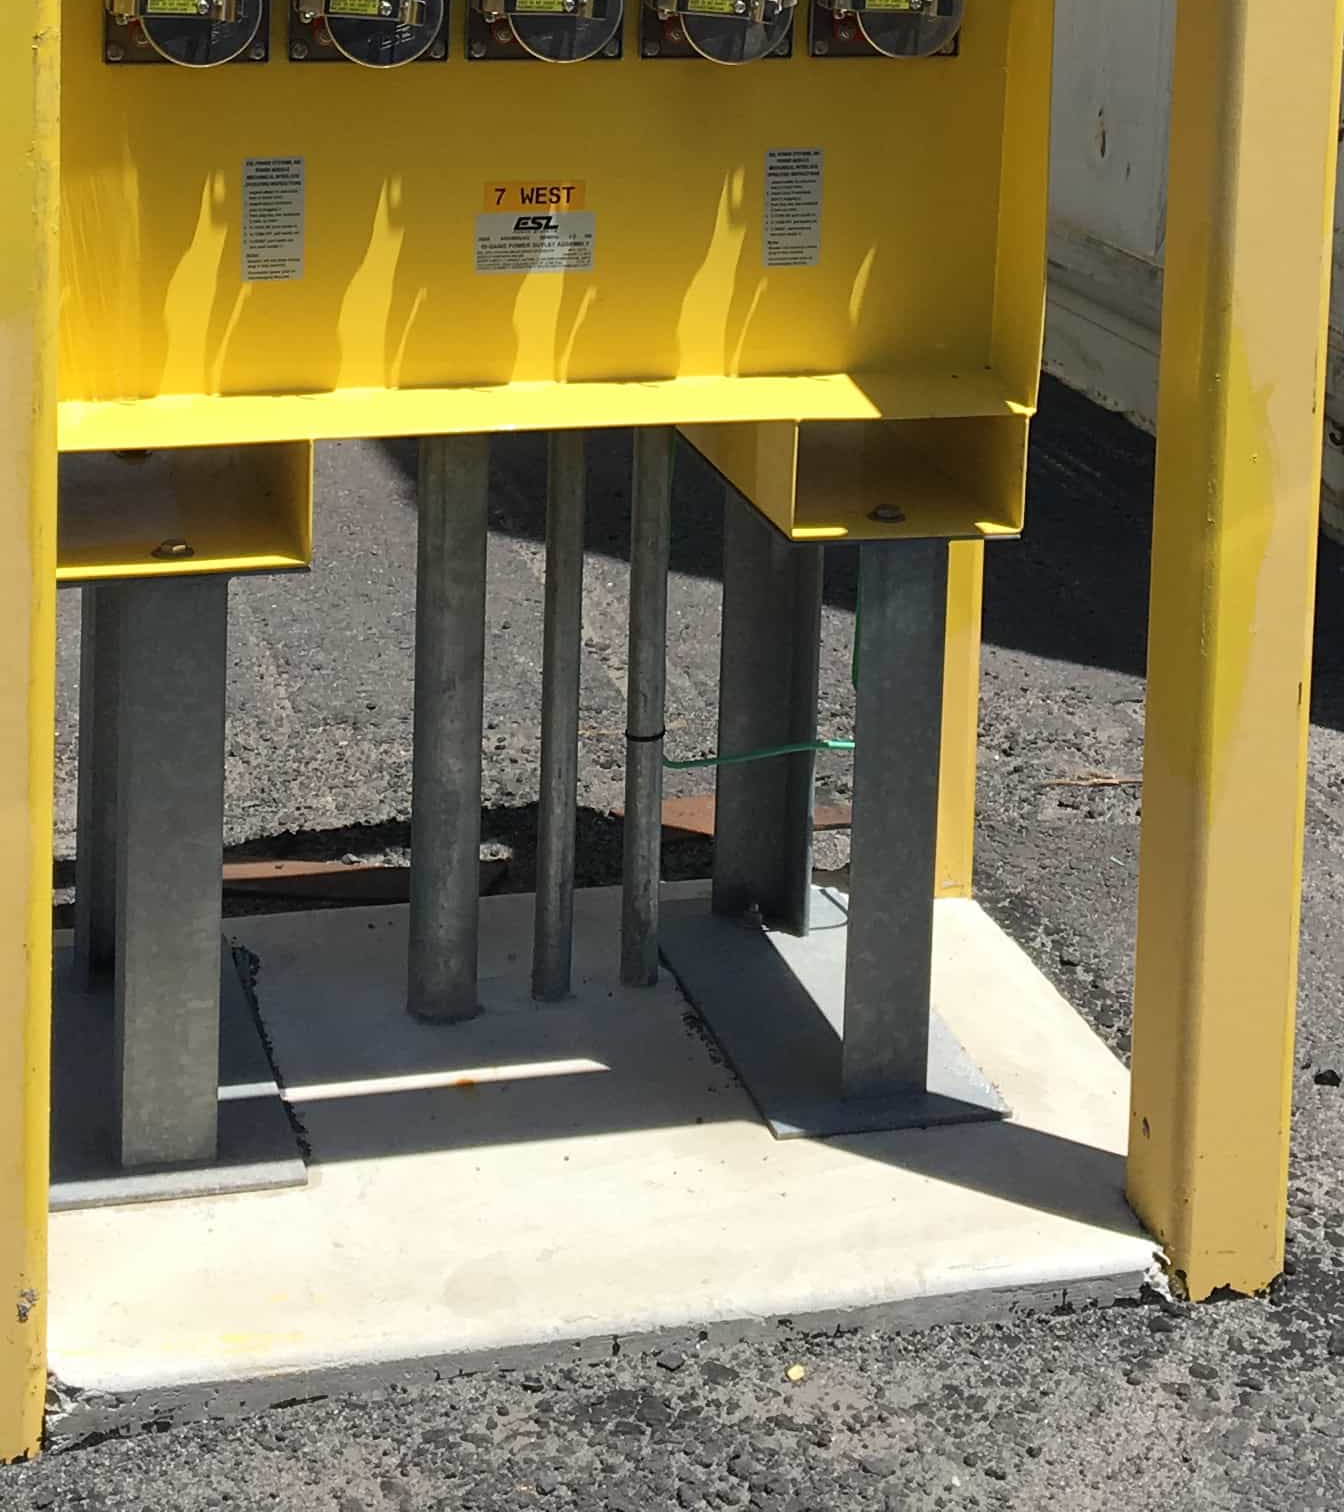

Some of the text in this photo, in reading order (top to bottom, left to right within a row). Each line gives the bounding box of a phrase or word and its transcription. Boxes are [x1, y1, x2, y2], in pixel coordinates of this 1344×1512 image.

[494, 186, 577, 206] 7 WEST
[512, 215, 560, 233] ESL
